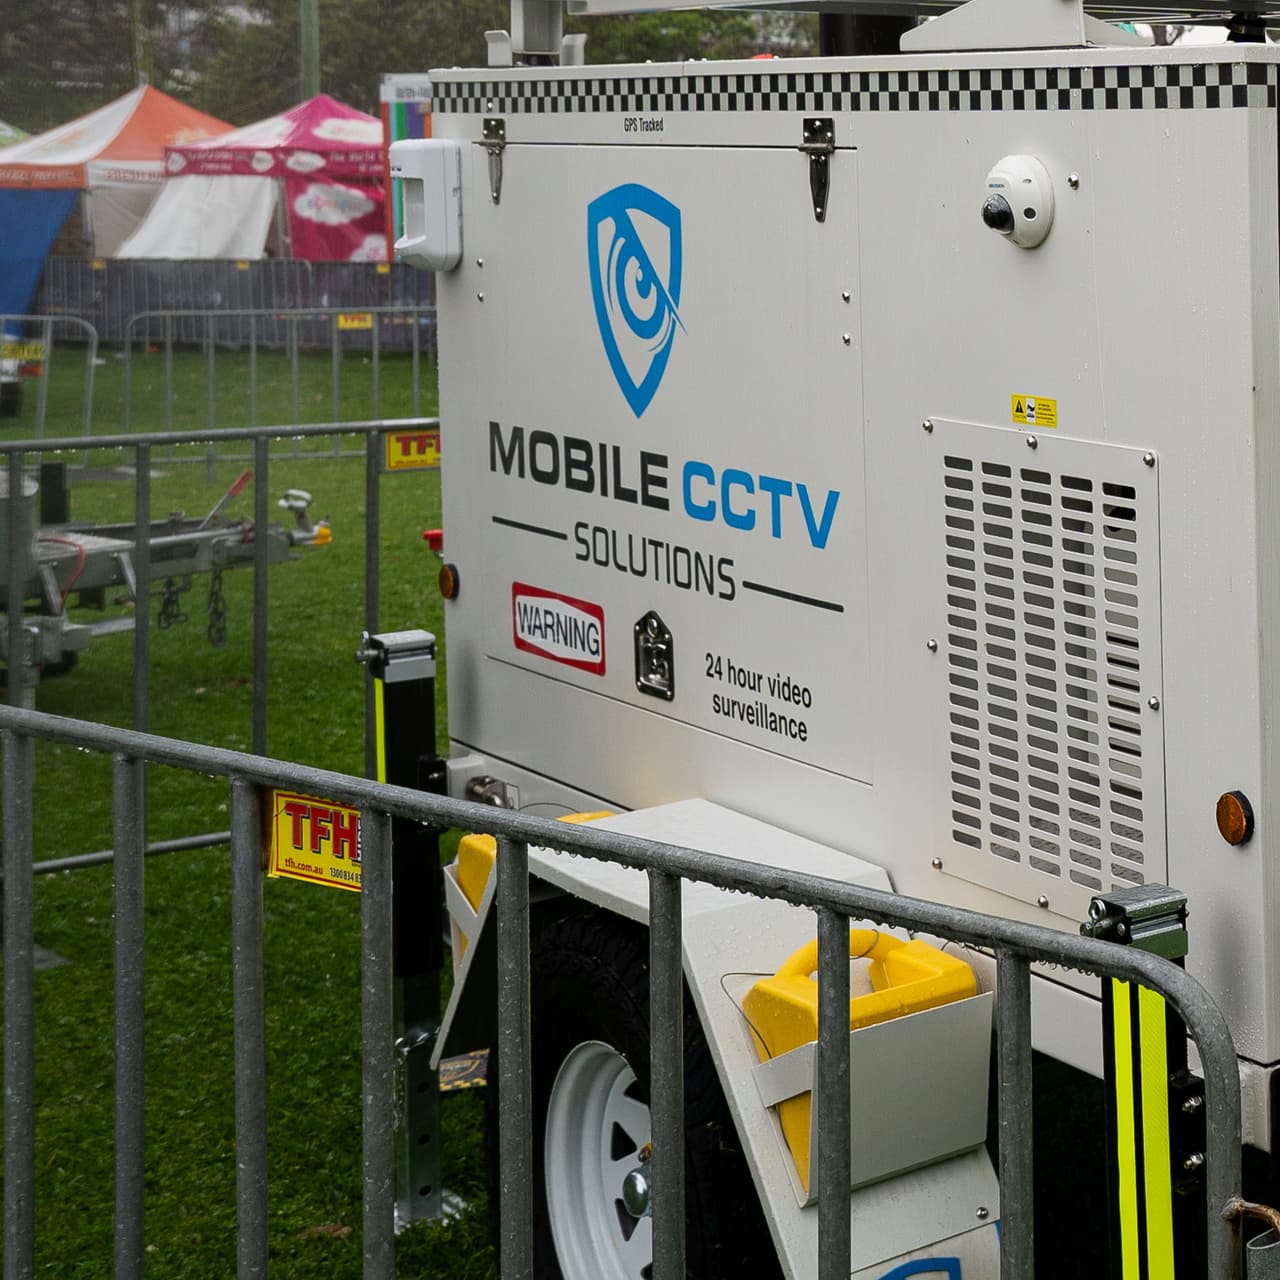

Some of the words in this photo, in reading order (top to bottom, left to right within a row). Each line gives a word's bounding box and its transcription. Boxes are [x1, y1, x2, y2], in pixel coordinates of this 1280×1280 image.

[624, 117, 638, 132] GPS
[639, 116, 664, 132] Tracked
[489, 421, 670, 511] MOBILE
[682, 460, 841, 550] CCTV
[574, 521, 736, 601] SOLUTIONS
[517, 601, 600, 657] WARNING
[705, 652, 723, 681] 24
[727, 658, 763, 693] hour
[768, 675, 812, 708] video
[712, 693, 808, 742] surveillance
[285, 801, 359, 861] TFH
[284, 858, 323, 875] tfh.com.au
